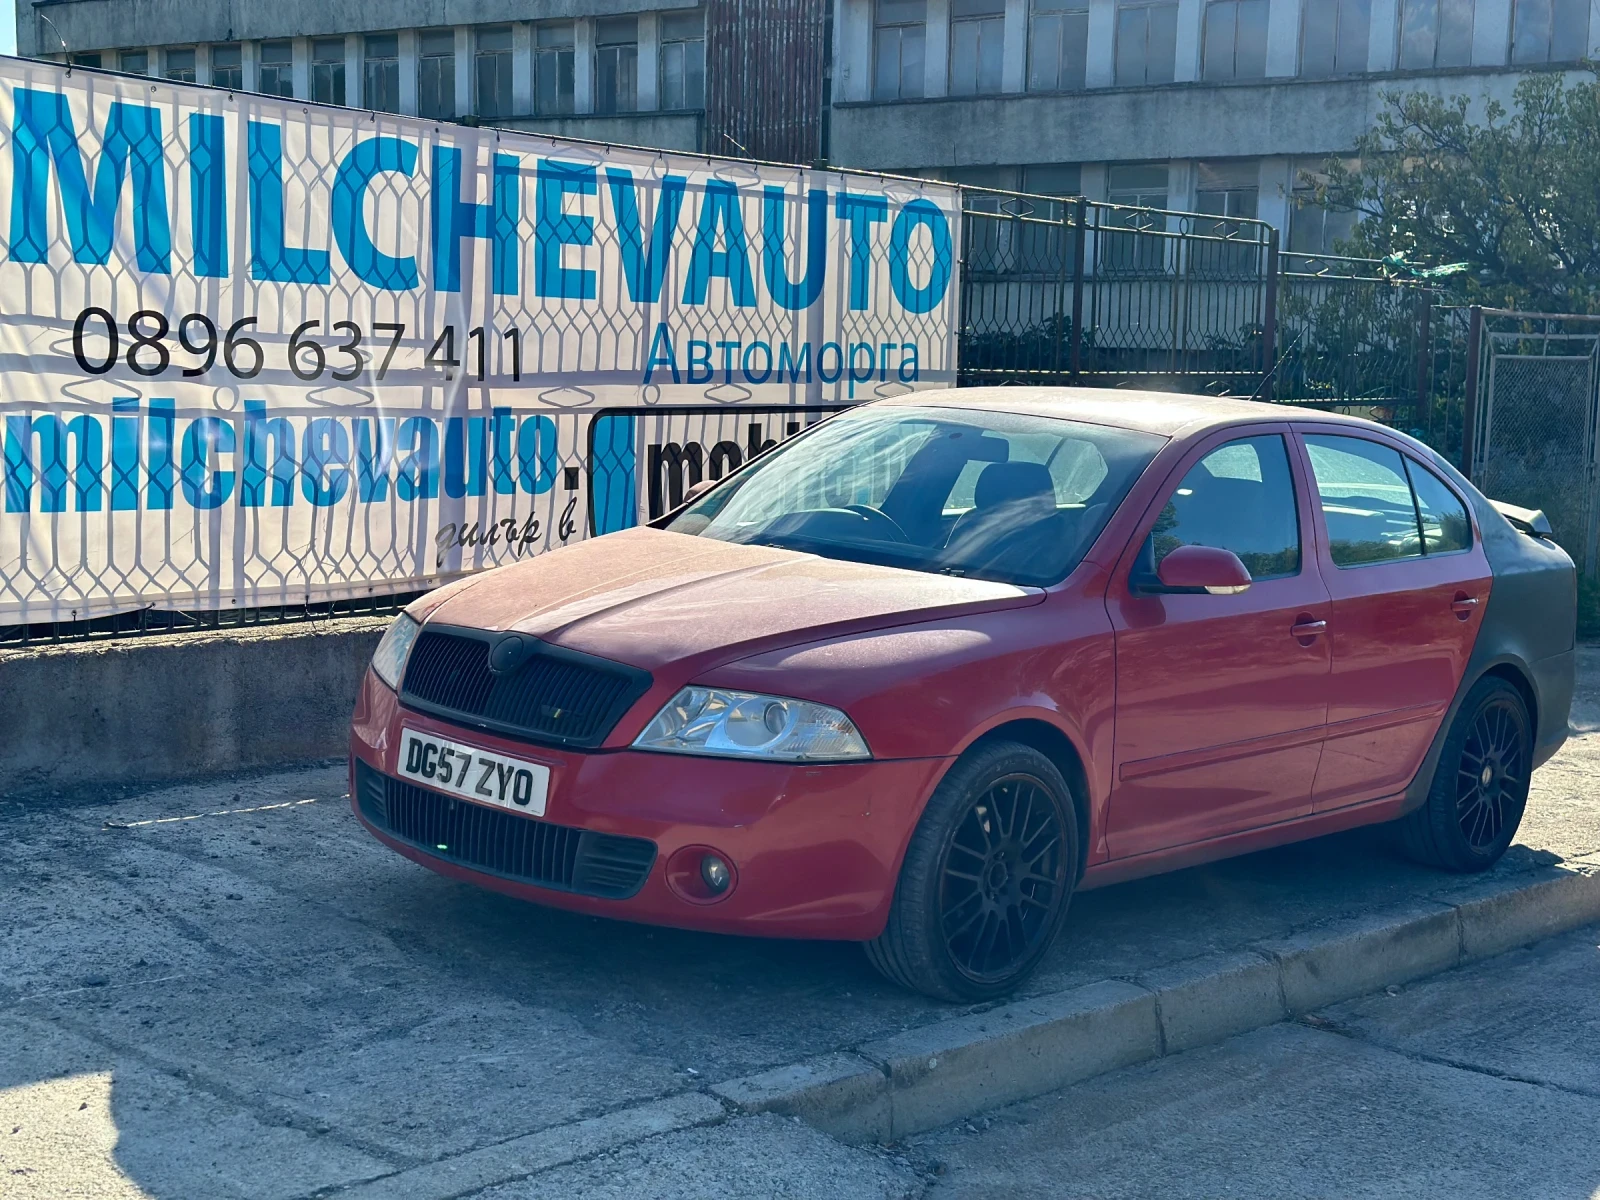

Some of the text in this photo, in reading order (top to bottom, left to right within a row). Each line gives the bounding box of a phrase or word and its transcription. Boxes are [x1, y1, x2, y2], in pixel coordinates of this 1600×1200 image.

[9, 87, 953, 314] MILCHEVAUTO
[72, 307, 521, 382] 0896 637 411
[643, 322, 919, 398] Автоморга
[406, 737, 533, 806] DG57 ZYO
